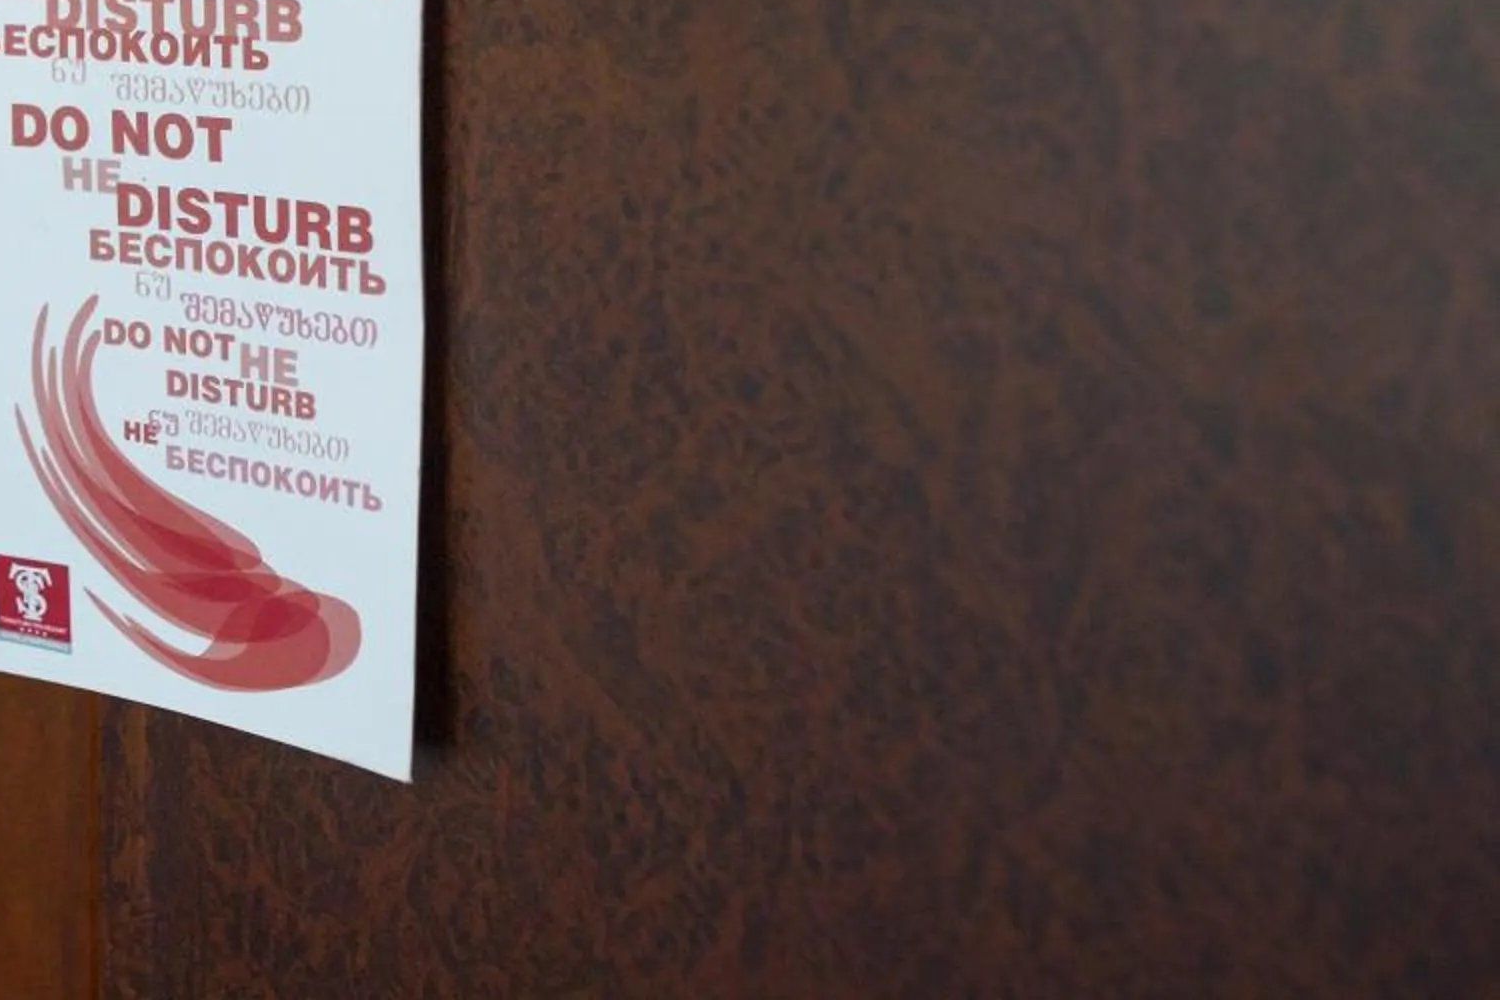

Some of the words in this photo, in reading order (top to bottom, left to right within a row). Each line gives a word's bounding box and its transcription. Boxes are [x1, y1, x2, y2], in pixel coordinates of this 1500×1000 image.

[11, 103, 90, 152] DO
[111, 109, 232, 163] NOT
[62, 156, 122, 194] НЕ
[116, 182, 375, 255] DISTURB
[89, 228, 387, 296] БЕСПОКОИТЬ
[102, 318, 152, 350] DO
[163, 325, 235, 362] NOT
[239, 342, 299, 388] НЕ
[166, 370, 317, 421] DISTURB
[123, 420, 159, 445] НЕ
[165, 444, 384, 512] БЕСПОКОИТЬ
